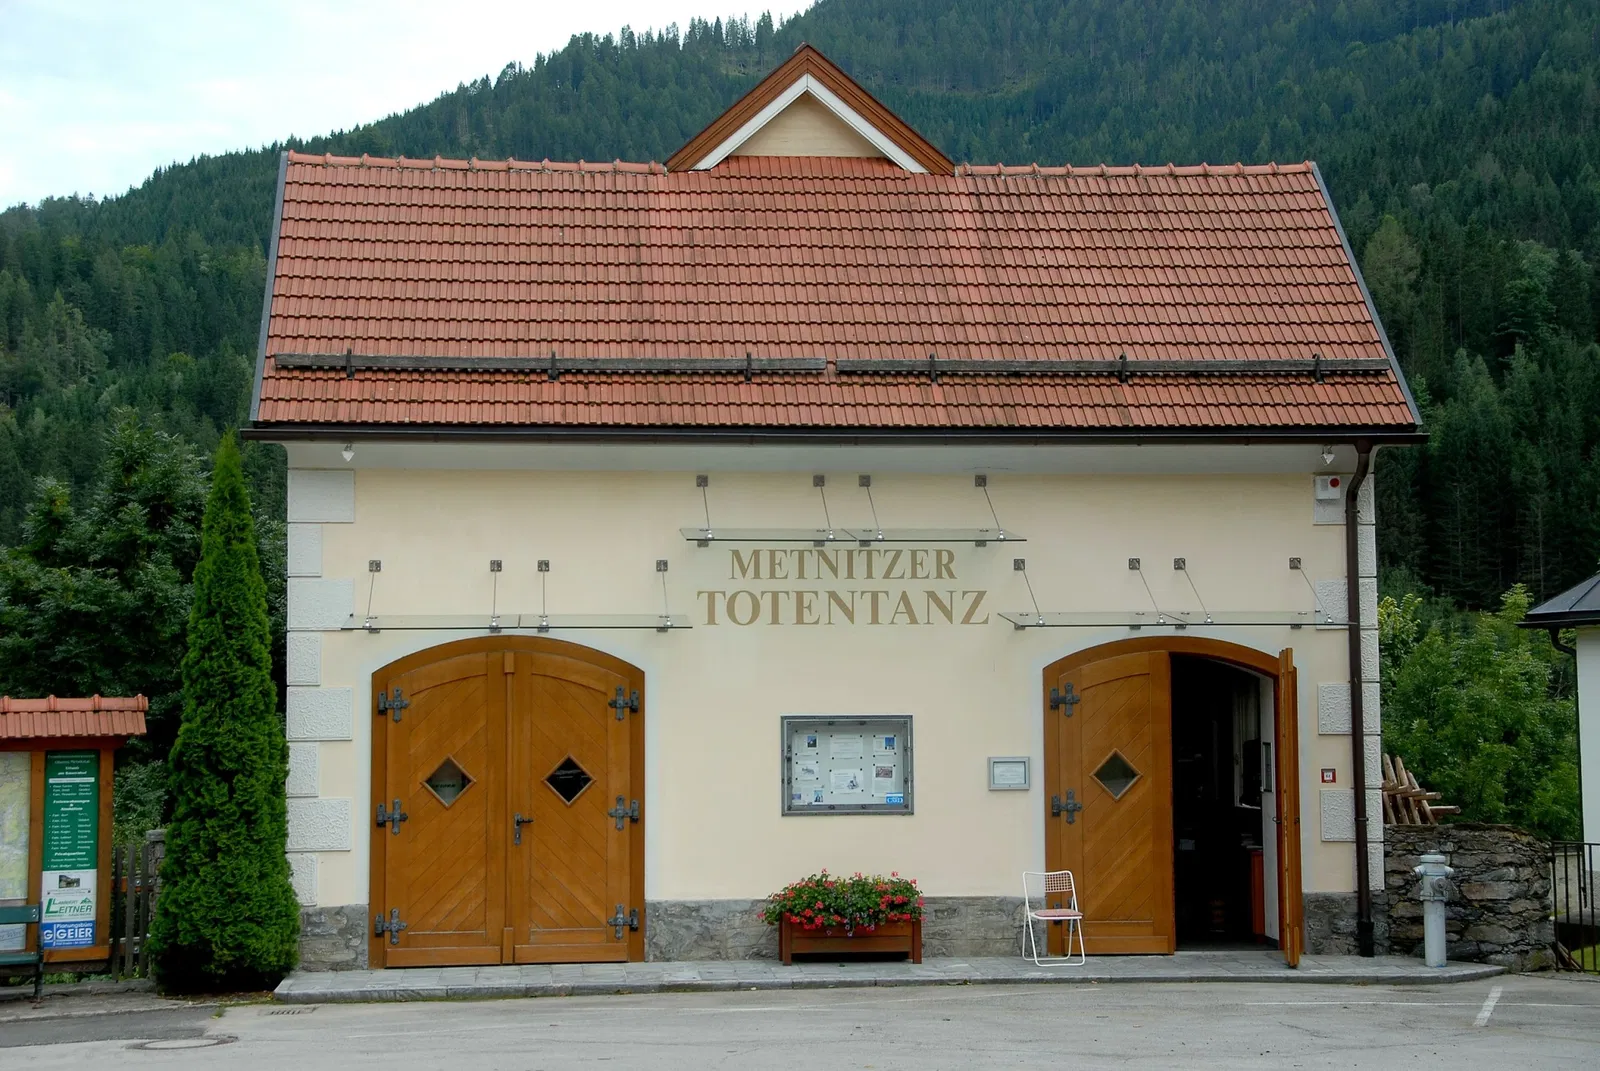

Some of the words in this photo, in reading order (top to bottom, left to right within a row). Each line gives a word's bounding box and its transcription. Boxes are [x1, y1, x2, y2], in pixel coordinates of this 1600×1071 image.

[728, 549, 958, 580] METNITZER
[696, 590, 990, 626] TOTENTANZ
[45, 898, 93, 914] LEITNER
[56, 928, 93, 939] GEIER
